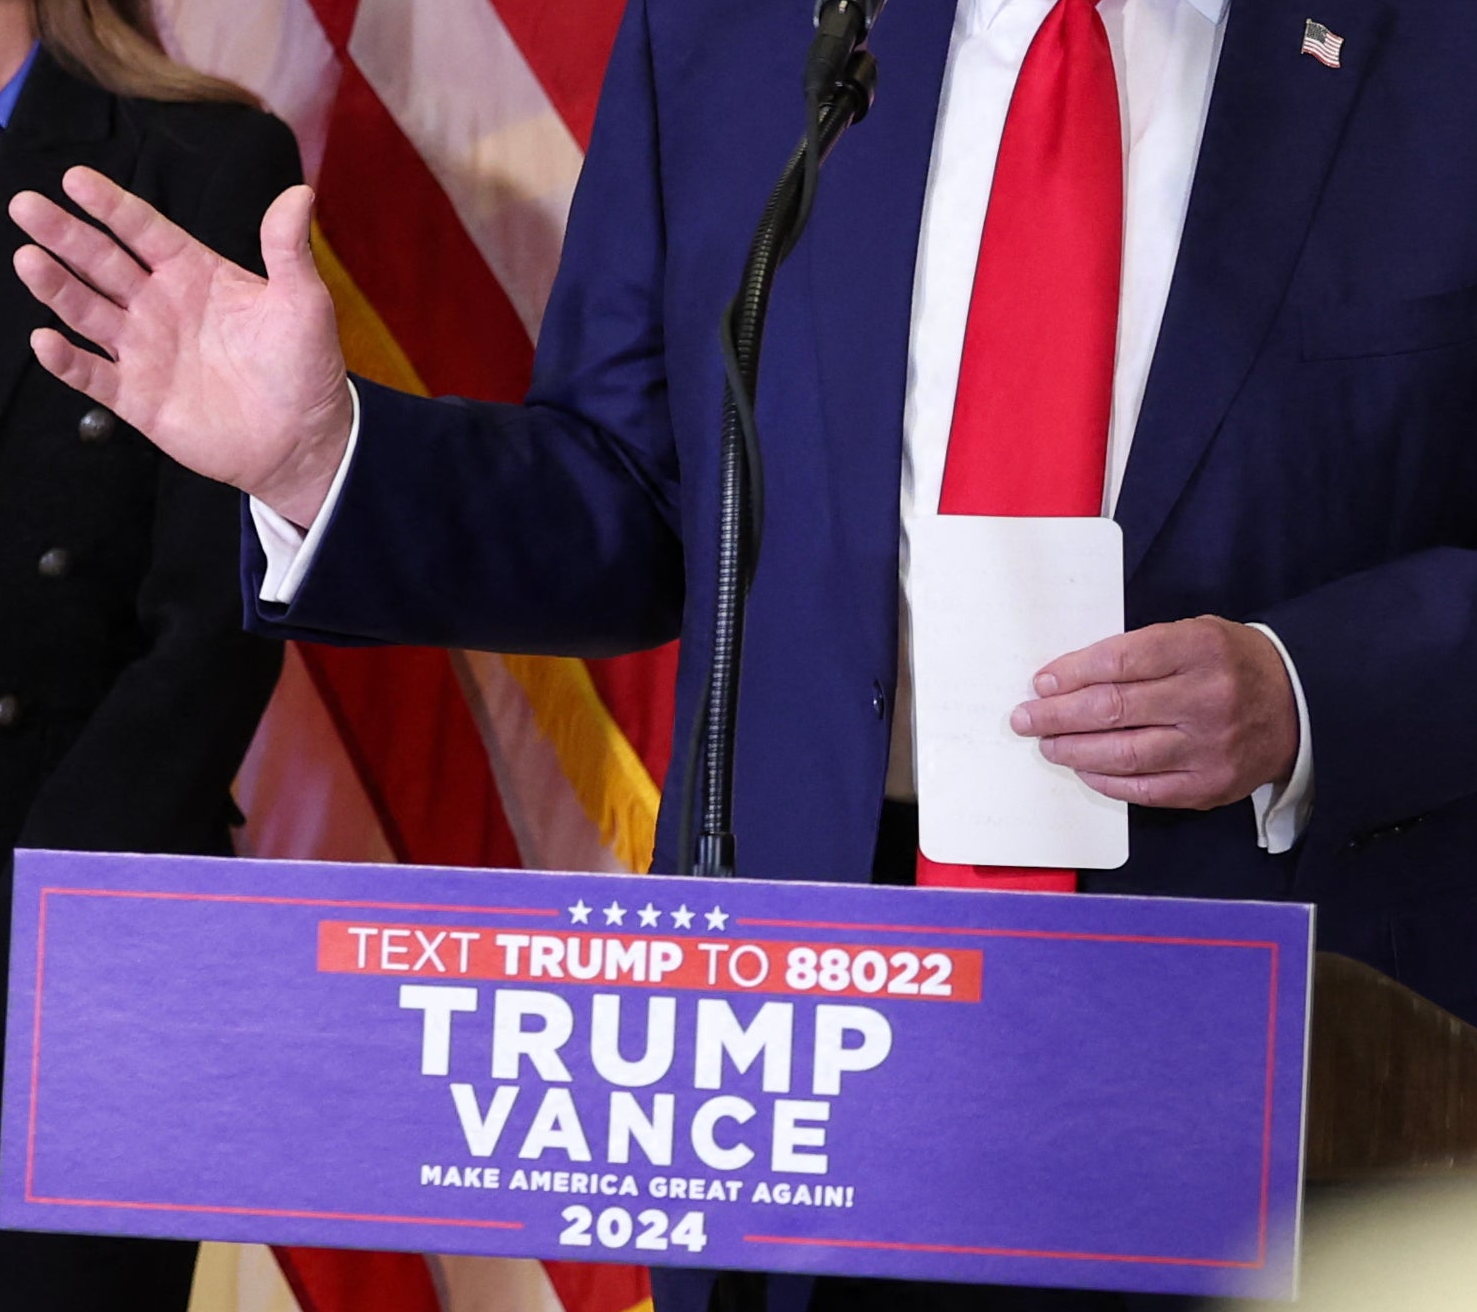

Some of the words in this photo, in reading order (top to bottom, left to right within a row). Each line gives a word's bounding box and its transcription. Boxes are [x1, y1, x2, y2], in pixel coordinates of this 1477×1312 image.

[347, 926, 481, 974] TEXT
[494, 933, 684, 983] TRUMP
[697, 942, 770, 988] TO
[784, 946, 953, 997] 88022
[398, 983, 893, 1097] TRUMP
[448, 1081, 831, 1175] VANCE
[420, 1163, 501, 1190] MAKE
[508, 1168, 640, 1198] AMERICA
[648, 1176, 744, 1203] GREAT
[751, 1181, 855, 1208] AGAIN!
[558, 1203, 708, 1253] 2024
